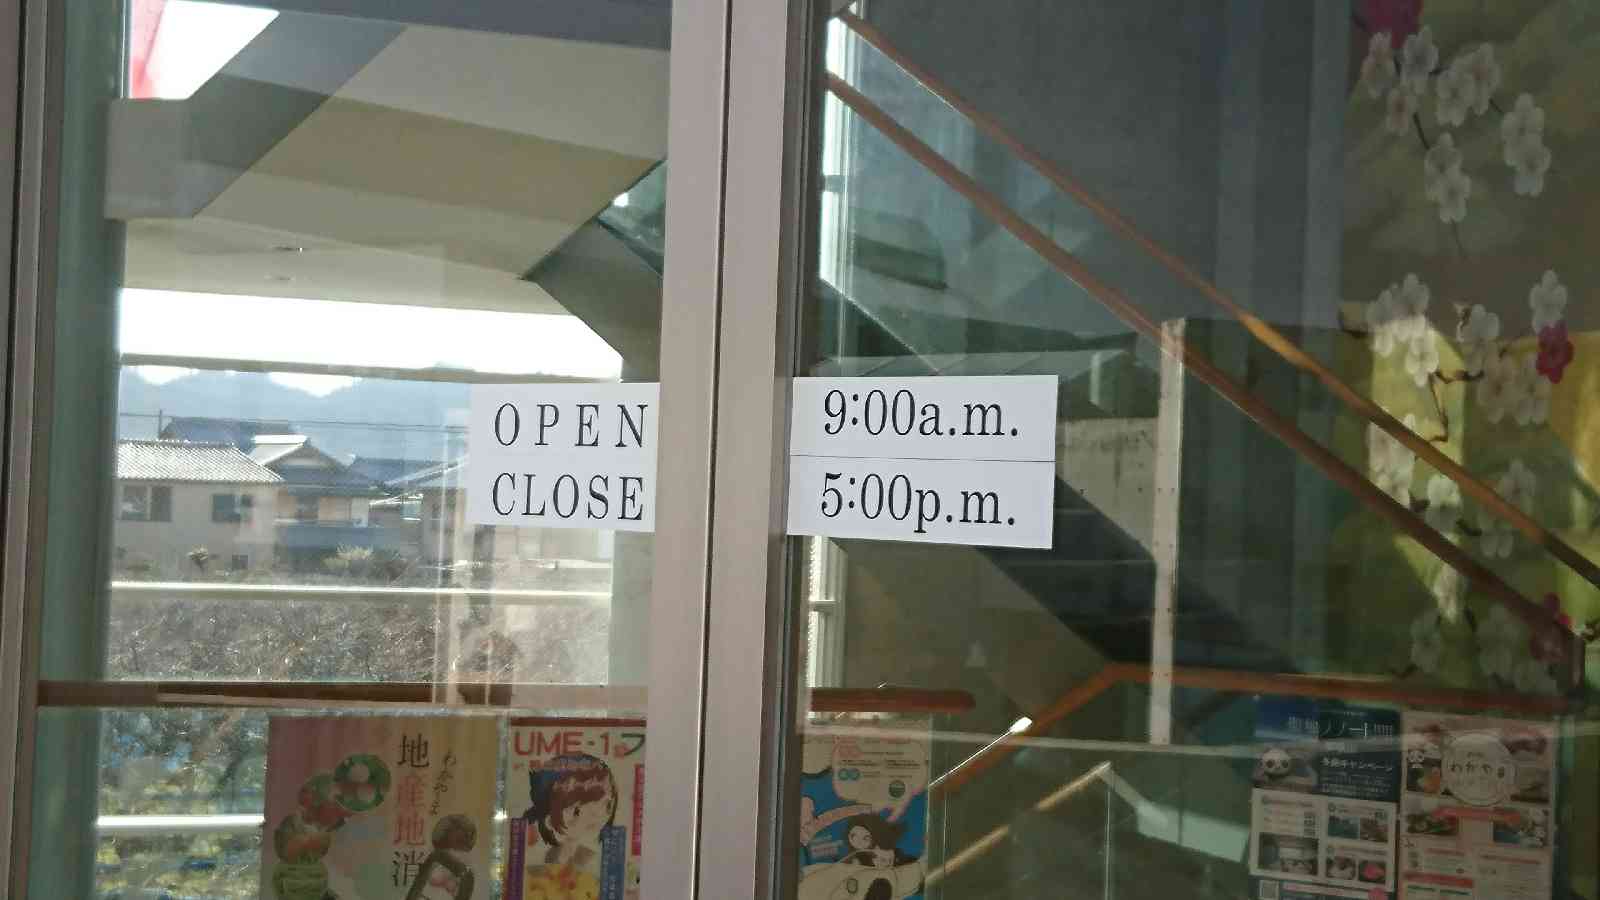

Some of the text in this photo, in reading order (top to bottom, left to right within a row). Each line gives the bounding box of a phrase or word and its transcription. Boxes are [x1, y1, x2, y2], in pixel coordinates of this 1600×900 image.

[494, 403, 649, 448] OPEN
[824, 389, 1019, 437] 9:00a.m.
[492, 472, 644, 521] CLOSE
[821, 472, 1016, 534] 5:00p.m.
[393, 733, 430, 887] 地産地消
